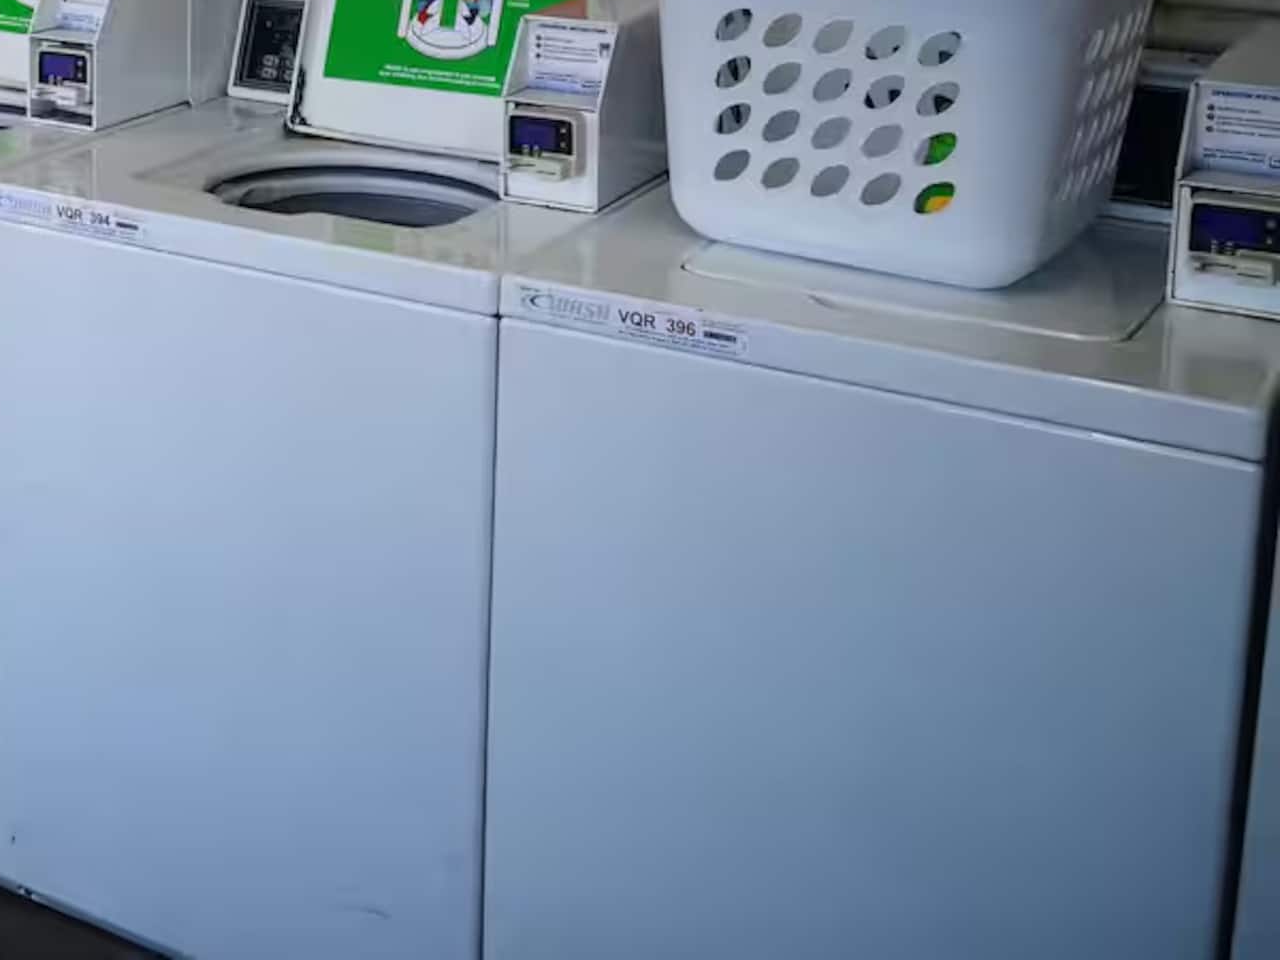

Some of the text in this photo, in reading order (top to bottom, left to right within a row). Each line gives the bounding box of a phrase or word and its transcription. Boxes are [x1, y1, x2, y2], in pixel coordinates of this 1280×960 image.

[56, 205, 83, 220] VQR
[619, 308, 656, 329] VQR
[666, 318, 696, 337] 396
